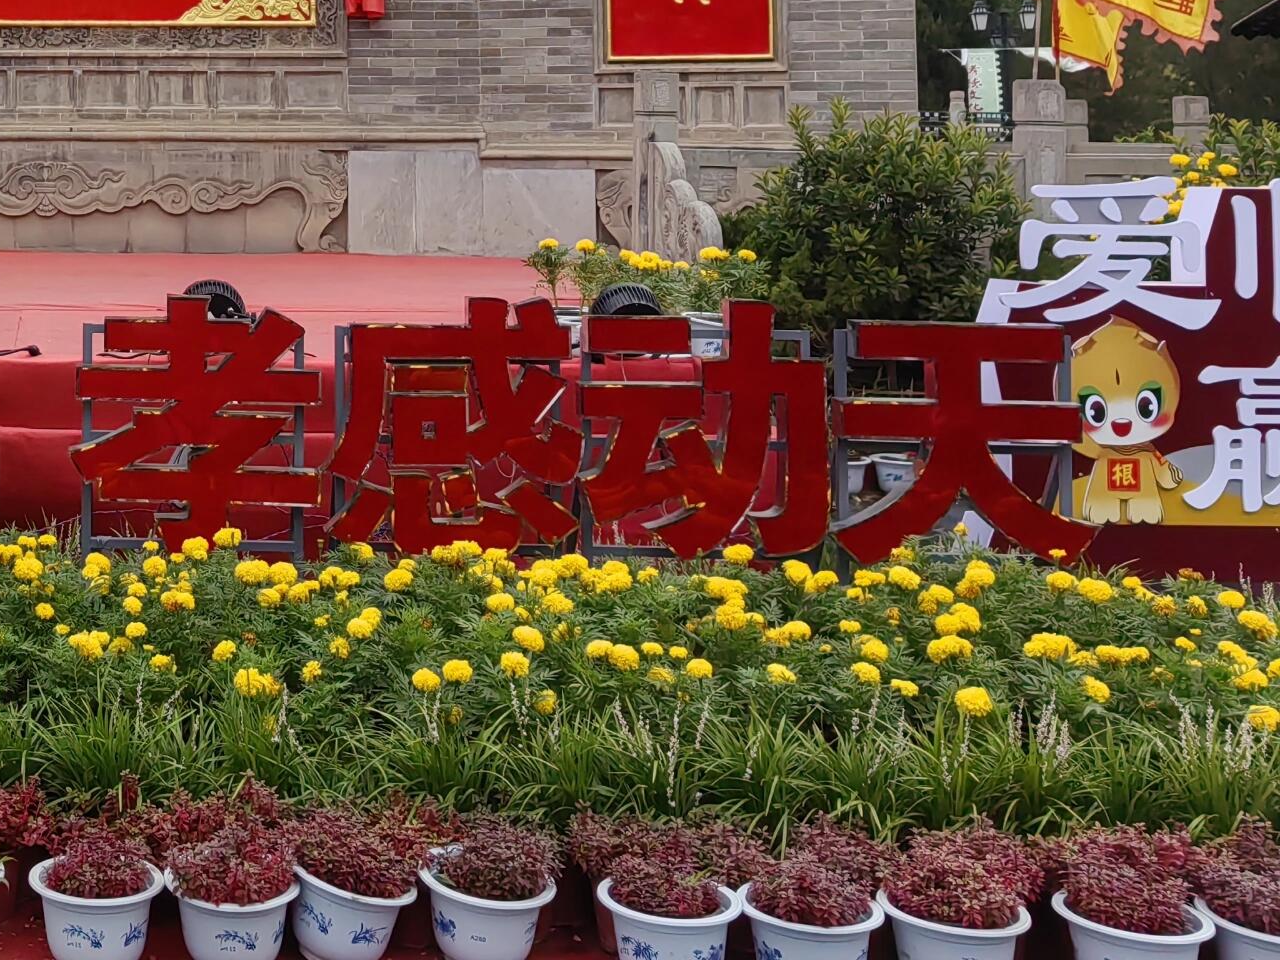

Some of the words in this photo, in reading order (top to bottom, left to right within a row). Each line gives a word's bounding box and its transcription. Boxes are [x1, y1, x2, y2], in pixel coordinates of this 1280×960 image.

[70, 295, 1100, 566] 孝感动天
[1111, 463, 1137, 487] 根
